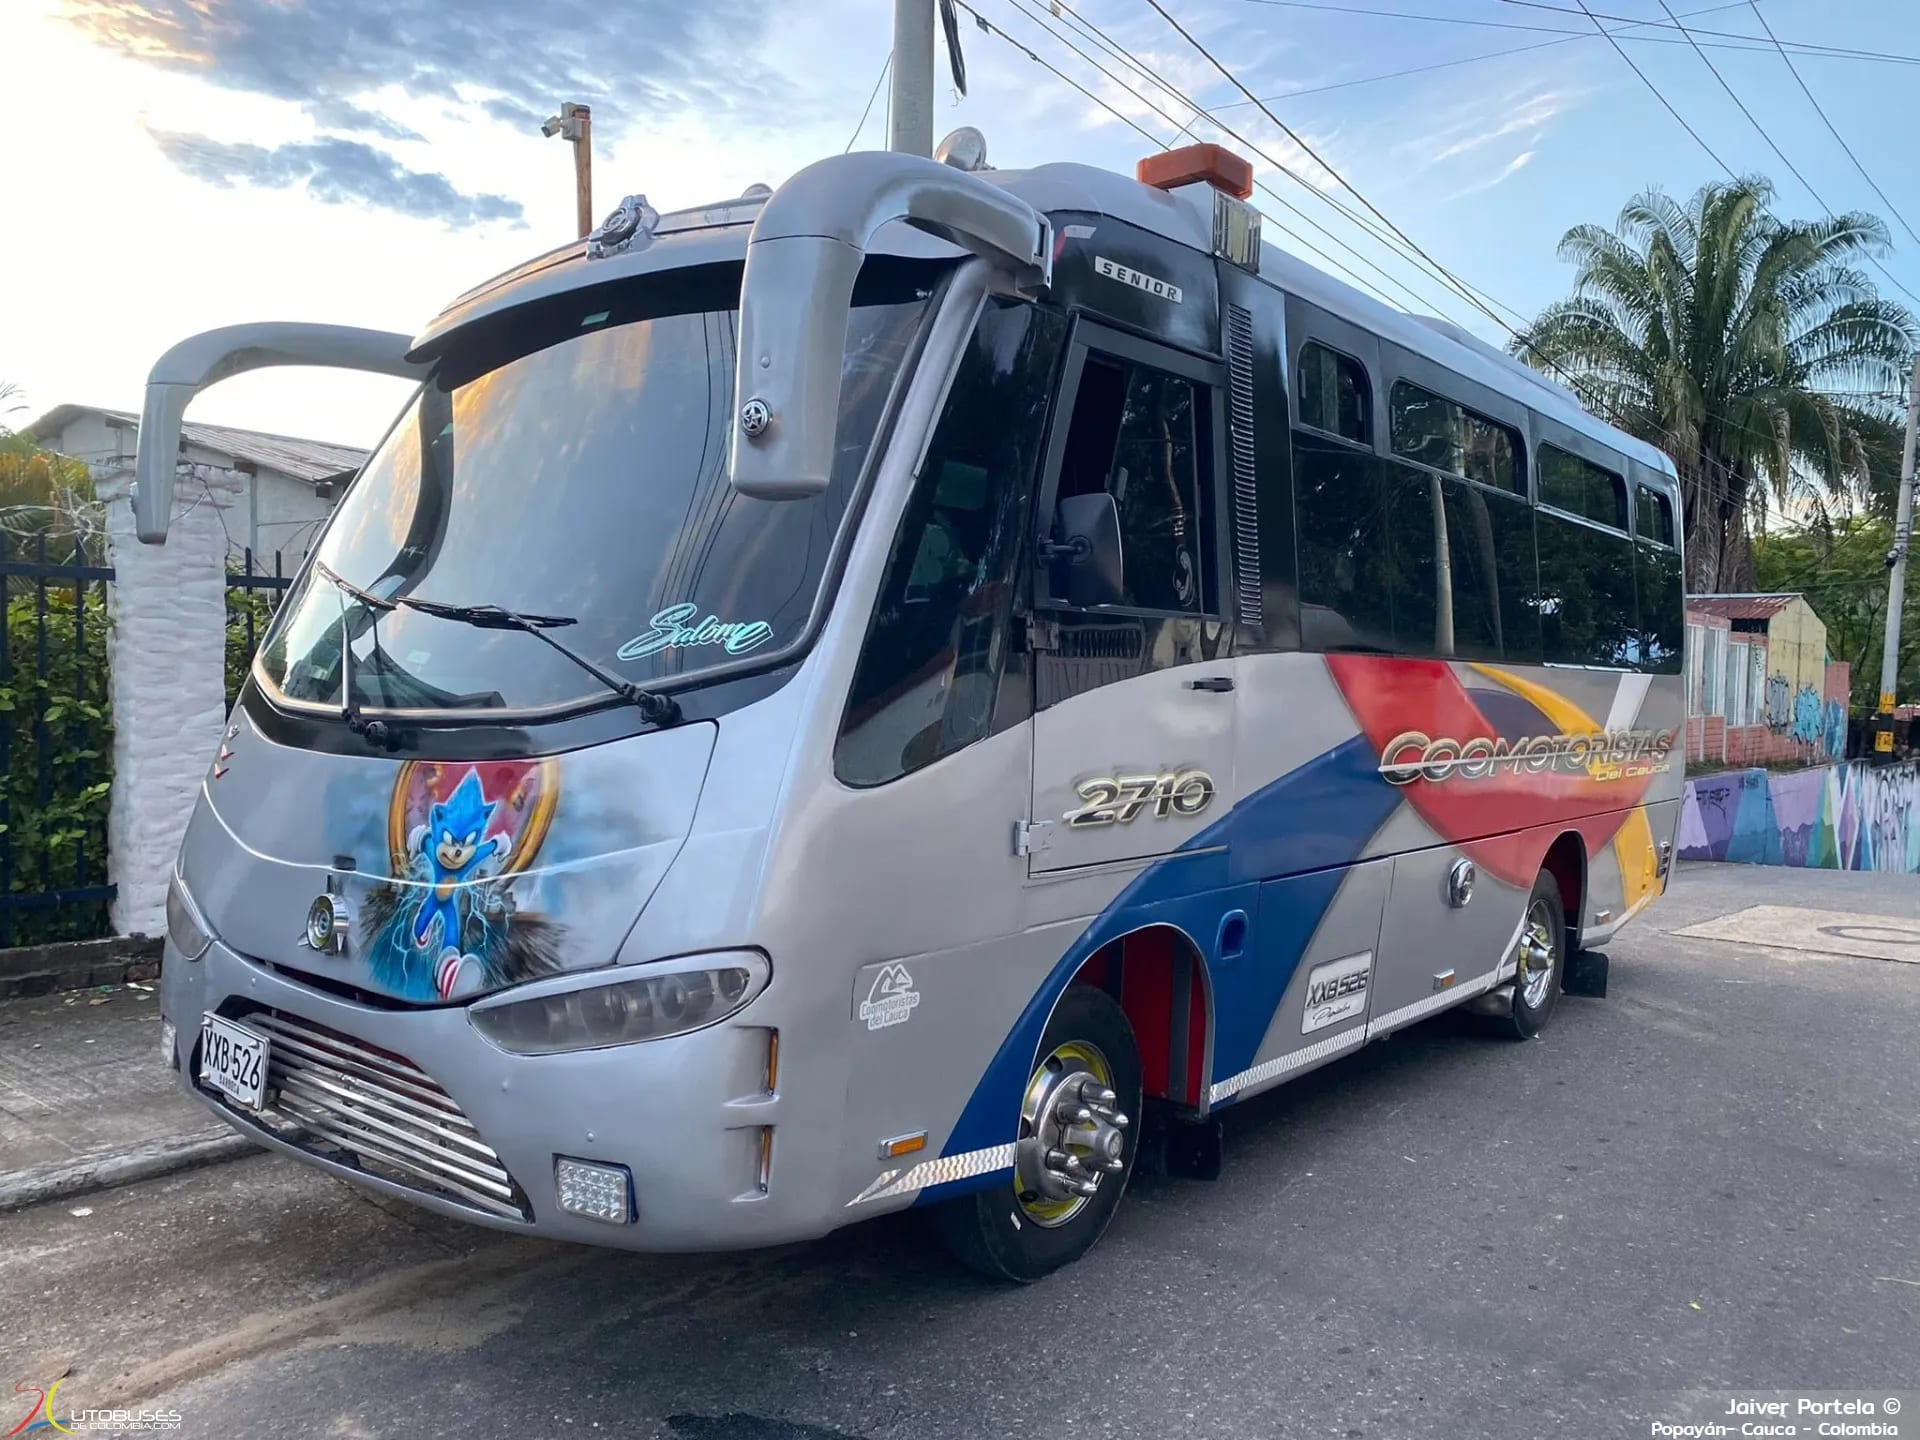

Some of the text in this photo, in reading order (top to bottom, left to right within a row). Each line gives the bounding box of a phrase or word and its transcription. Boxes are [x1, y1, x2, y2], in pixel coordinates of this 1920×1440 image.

[1102, 262, 1177, 300] SENIOR
[1595, 763, 1671, 782] Del Cauca
[1068, 770, 1215, 827] 2710
